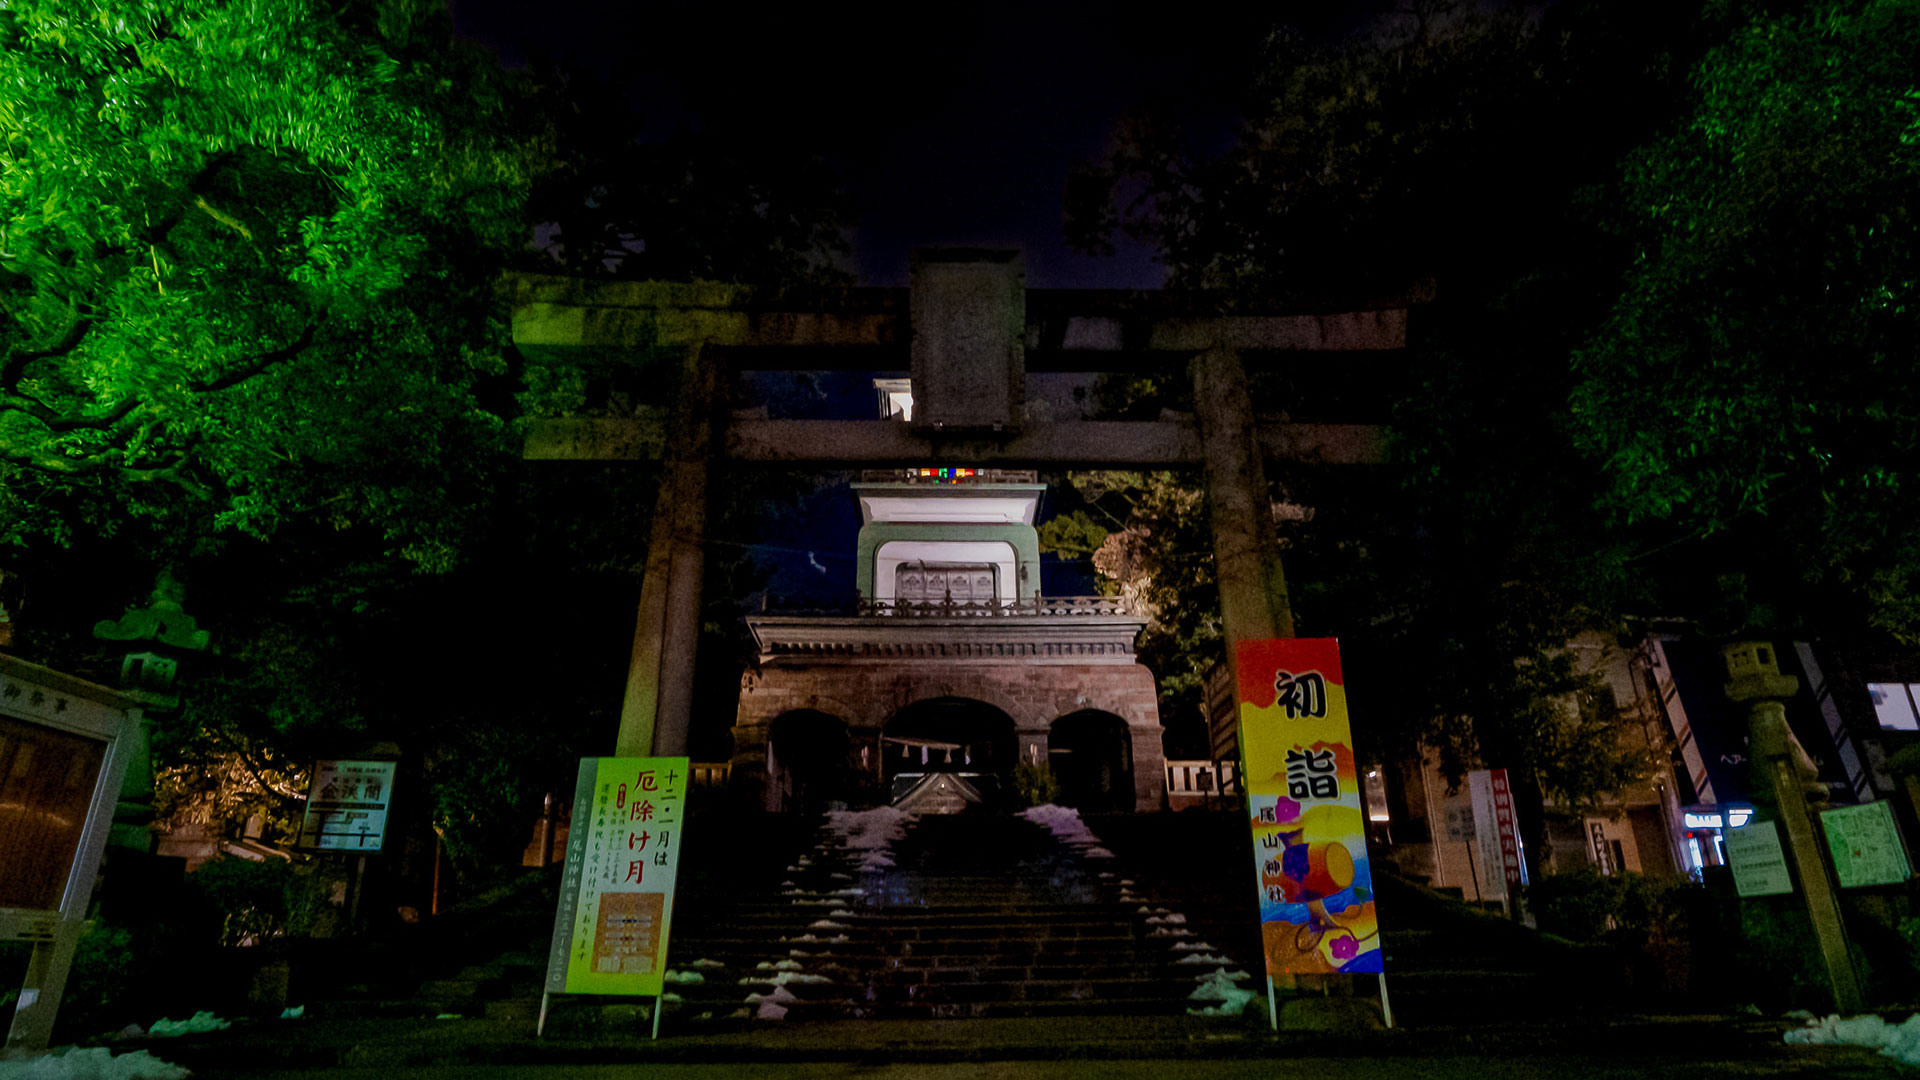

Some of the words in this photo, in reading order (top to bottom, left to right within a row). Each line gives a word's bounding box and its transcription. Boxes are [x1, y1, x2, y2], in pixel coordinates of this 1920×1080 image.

[1277, 671, 1339, 799] 初詣
[624, 770, 659, 885] 厄除け月
[654, 769, 679, 866] 十二・一月は
[1259, 806, 1285, 903] 尾山神社
